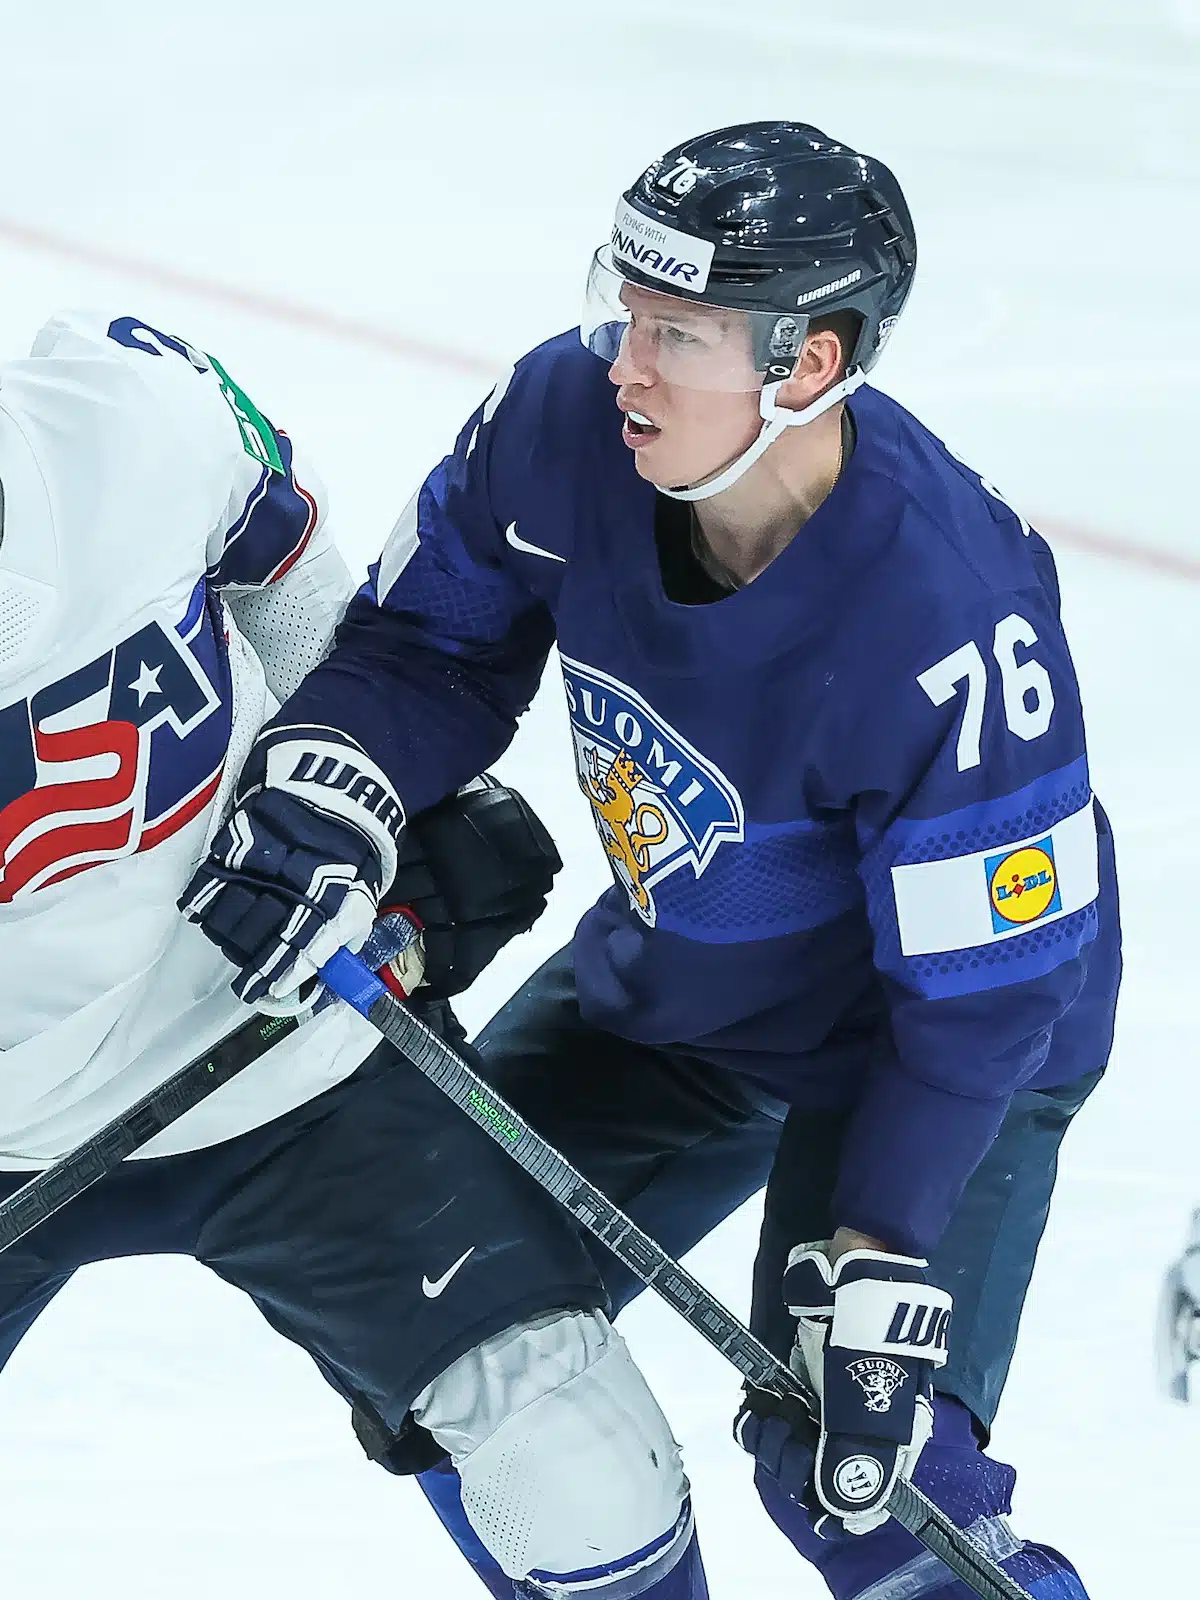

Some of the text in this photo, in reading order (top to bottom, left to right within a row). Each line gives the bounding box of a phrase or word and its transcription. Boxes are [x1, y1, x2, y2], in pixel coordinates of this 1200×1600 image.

[657, 155, 701, 198] 76
[622, 212, 667, 244] FLYING WITH
[796, 269, 861, 306] WARRIOR
[915, 612, 1055, 773] 76
[565, 678, 705, 807] SUOMI
[206, 1062, 215, 1073] 6
[468, 1088, 521, 1140] NANOLITE
[857, 1360, 900, 1377] SUOMI
